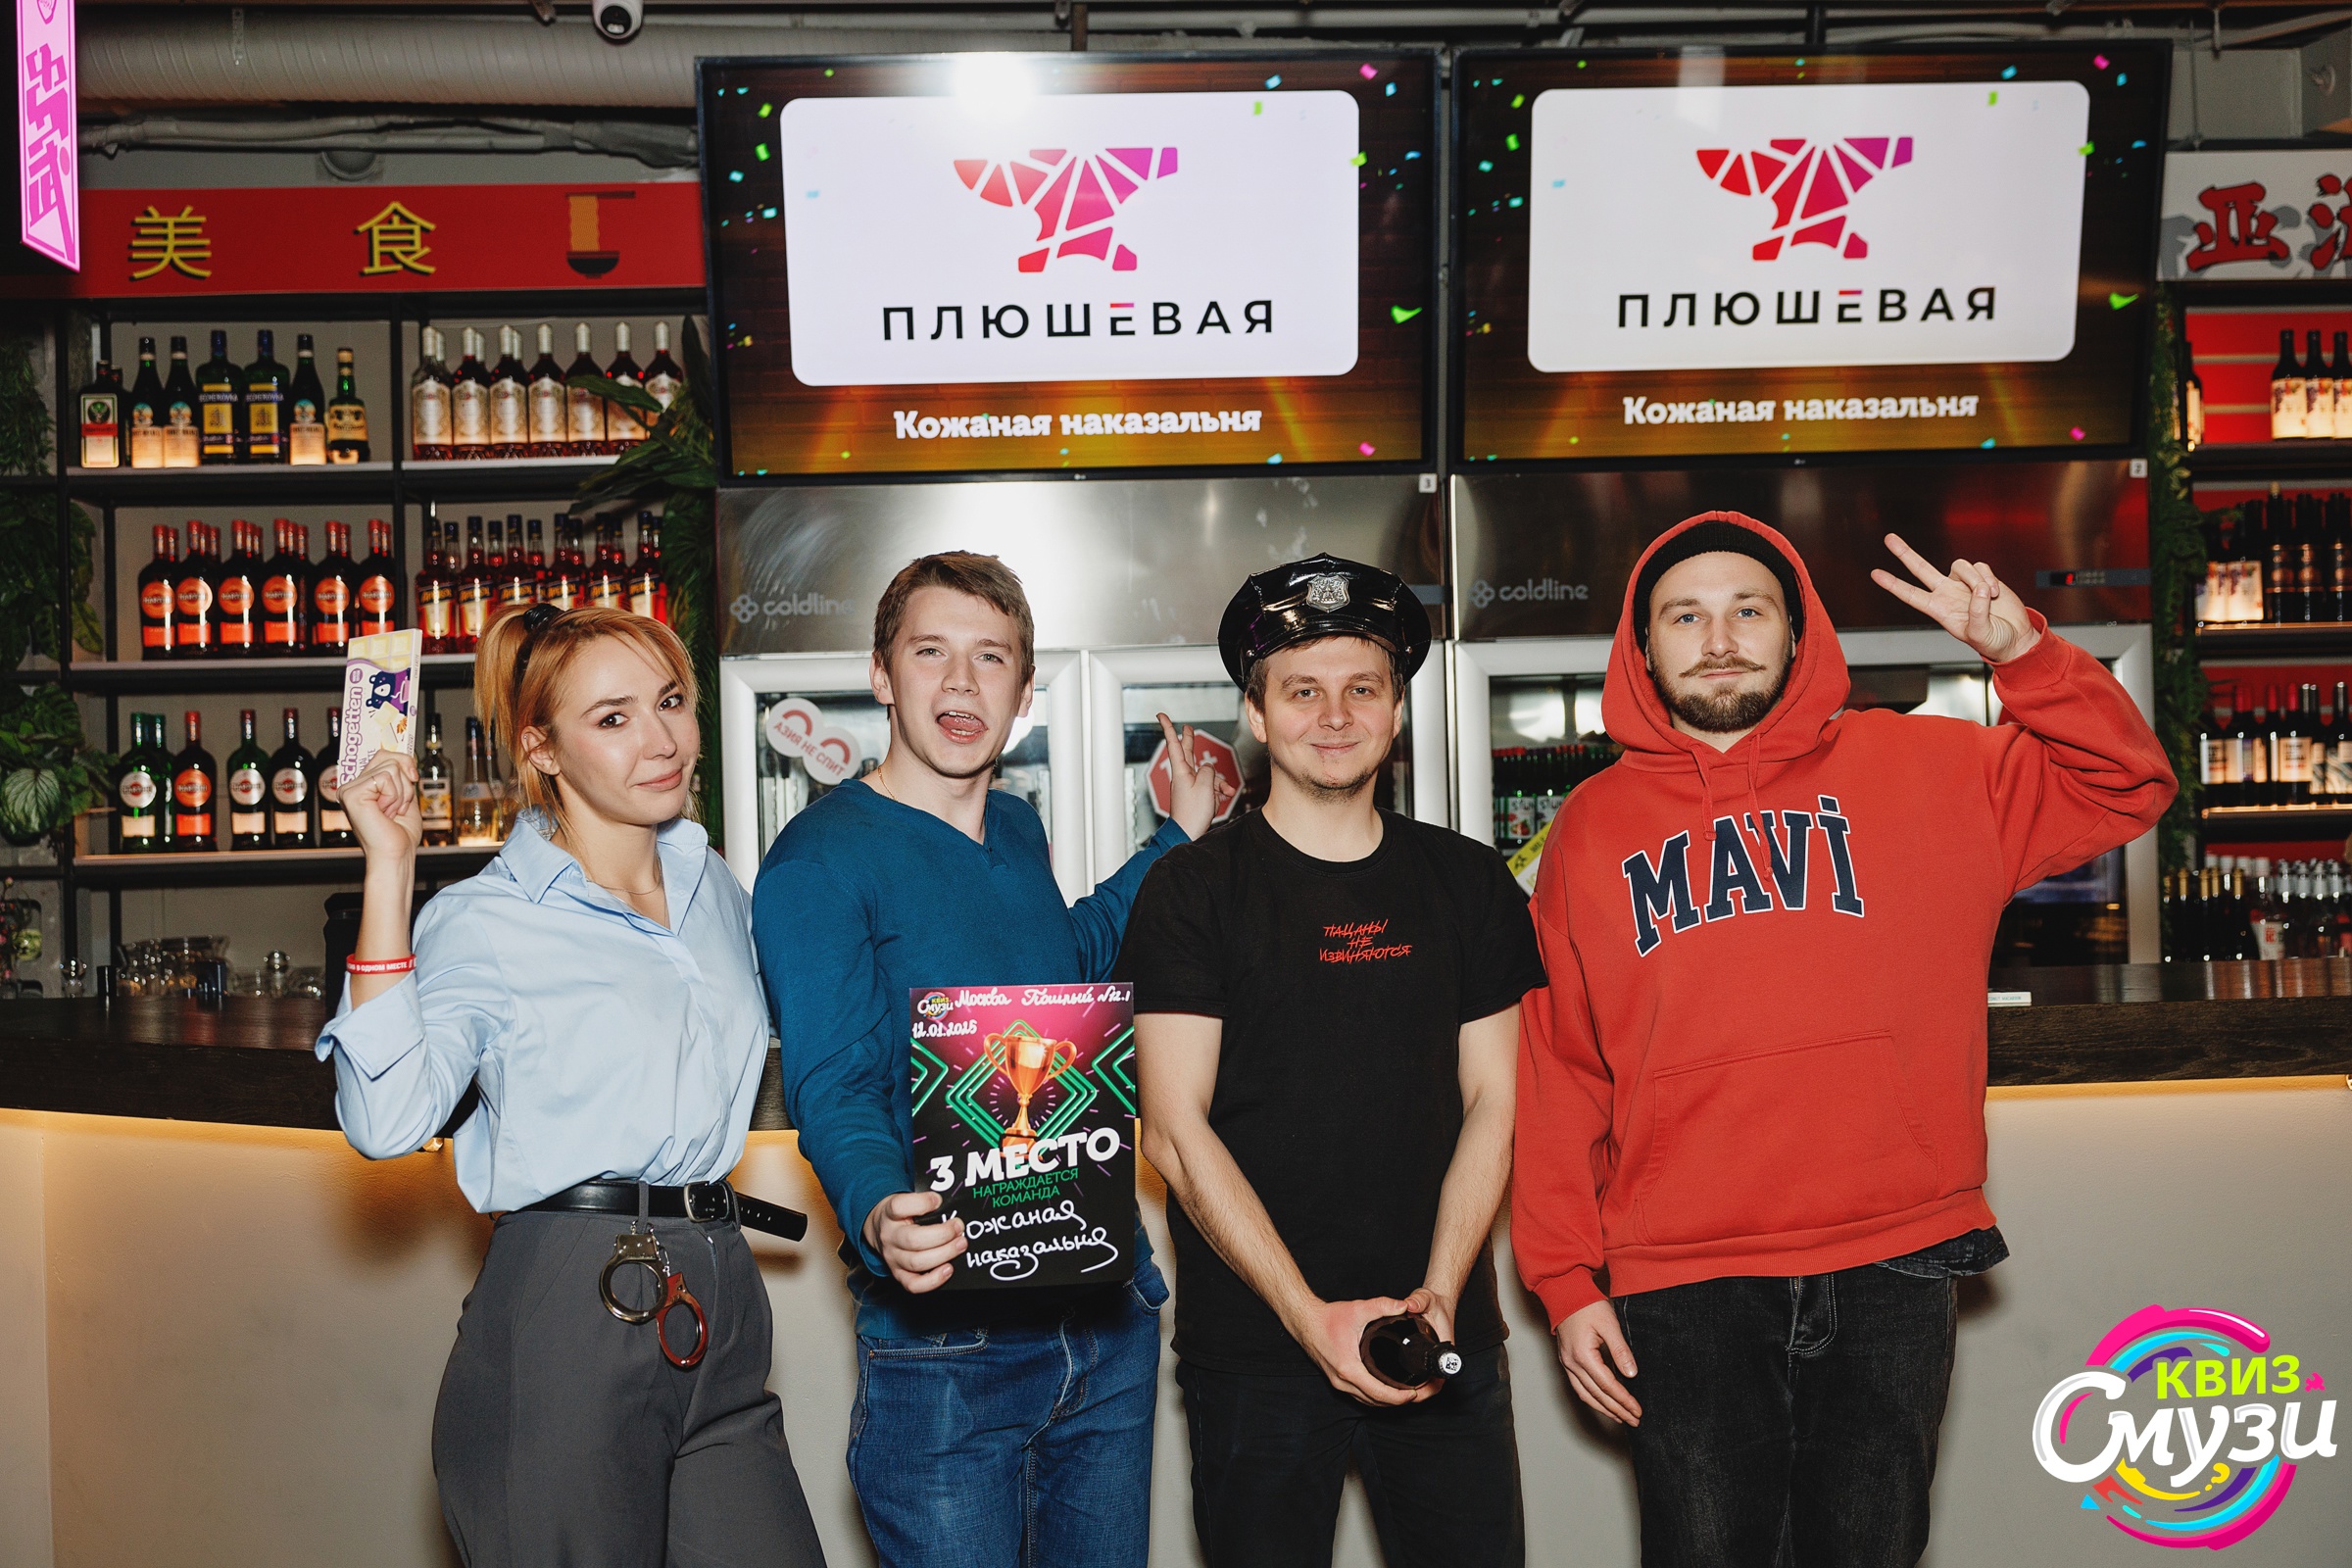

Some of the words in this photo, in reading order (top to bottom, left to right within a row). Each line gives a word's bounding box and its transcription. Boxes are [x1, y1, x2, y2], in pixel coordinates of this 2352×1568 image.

[1618, 286, 1996, 327] ПЛЮШЕВАЯ
[883, 300, 1273, 340] ПЛЮШЕВАЯ
[1623, 396, 1777, 424] Кожаная
[1784, 395, 1980, 421] наказальня
[893, 410, 1052, 440] Кожаная
[1059, 410, 1263, 437] наказальня
[1499, 578, 1590, 602] coldline
[762, 592, 856, 616] coldline
[340, 685, 364, 786] Schogetten
[773, 721, 804, 746] АЗИЯ
[801, 740, 817, 758] НЕ
[815, 752, 847, 776] СПИТ
[1323, 918, 1389, 939] ПАЦАНЫ
[1319, 943, 1413, 963] ИЗВИНЯЮТСЯ
[1347, 935, 1374, 950] НЕ
[361, 963, 385, 973] ОДНОМ
[386, 961, 408, 971] МЕСТЕ
[917, 999, 954, 1015] Смузи
[955, 987, 1012, 1008] Москва
[930, 1155, 956, 1193] 3
[964, 1127, 1120, 1188] МЕСТО
[973, 1168, 1079, 1200] НАГРАЖДАЕТСЯ
[992, 1185, 1061, 1208] КОМАНДА
[966, 1227, 1119, 1281] наказальня
